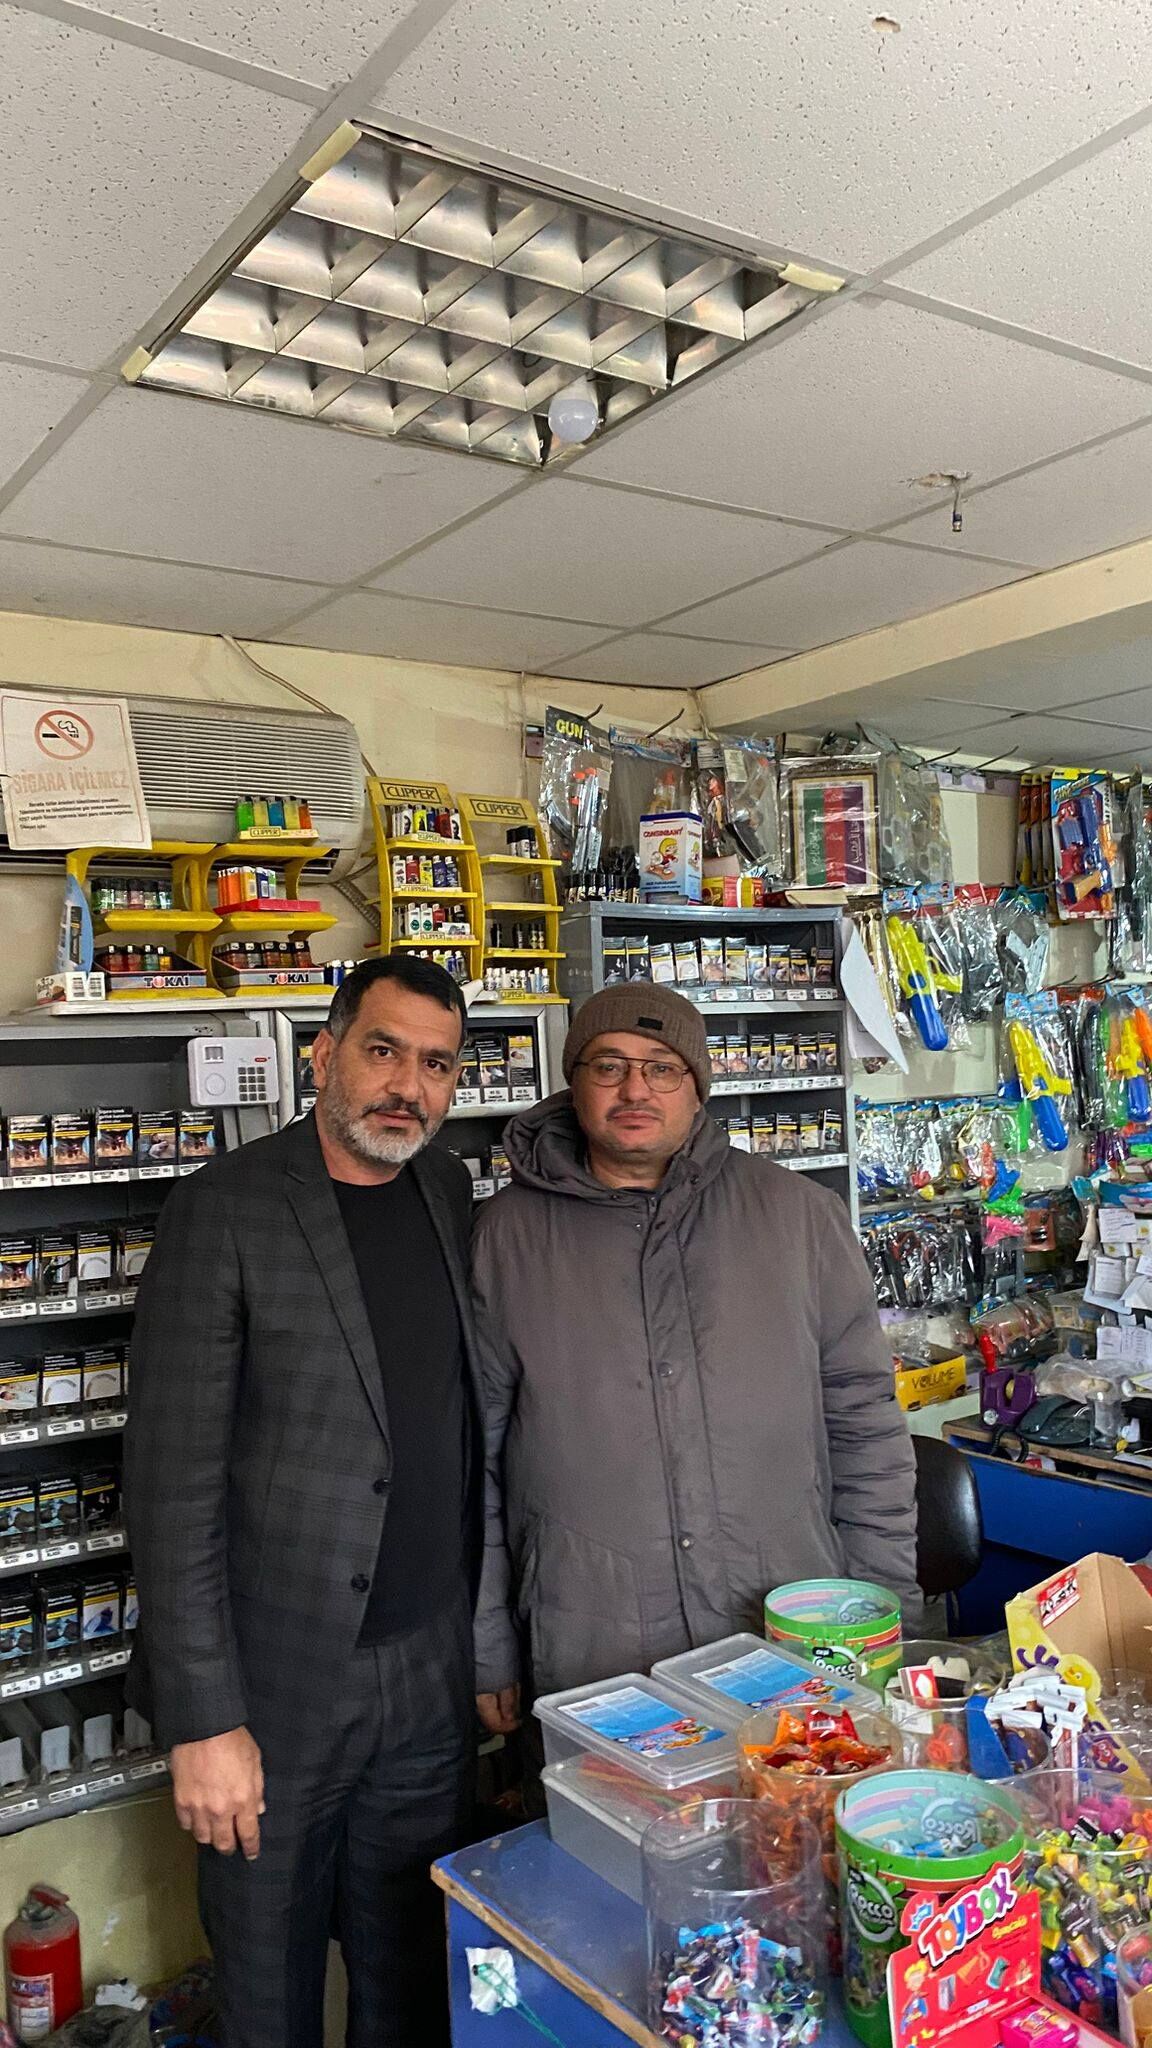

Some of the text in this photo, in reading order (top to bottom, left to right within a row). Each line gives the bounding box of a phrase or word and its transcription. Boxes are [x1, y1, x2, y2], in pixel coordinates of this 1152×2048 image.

[555, 719, 583, 740] GUN
[12, 766, 130, 796] SİGARA İÇİLMEZ
[386, 785, 436, 800] CLIPPER
[476, 801, 522, 816] CLIPPER
[144, 975, 190, 988] TOKAI
[268, 973, 309, 985] TOKAI
[911, 1366, 955, 1391] VOLUME
[919, 1869, 1017, 1965] TOYBOX
